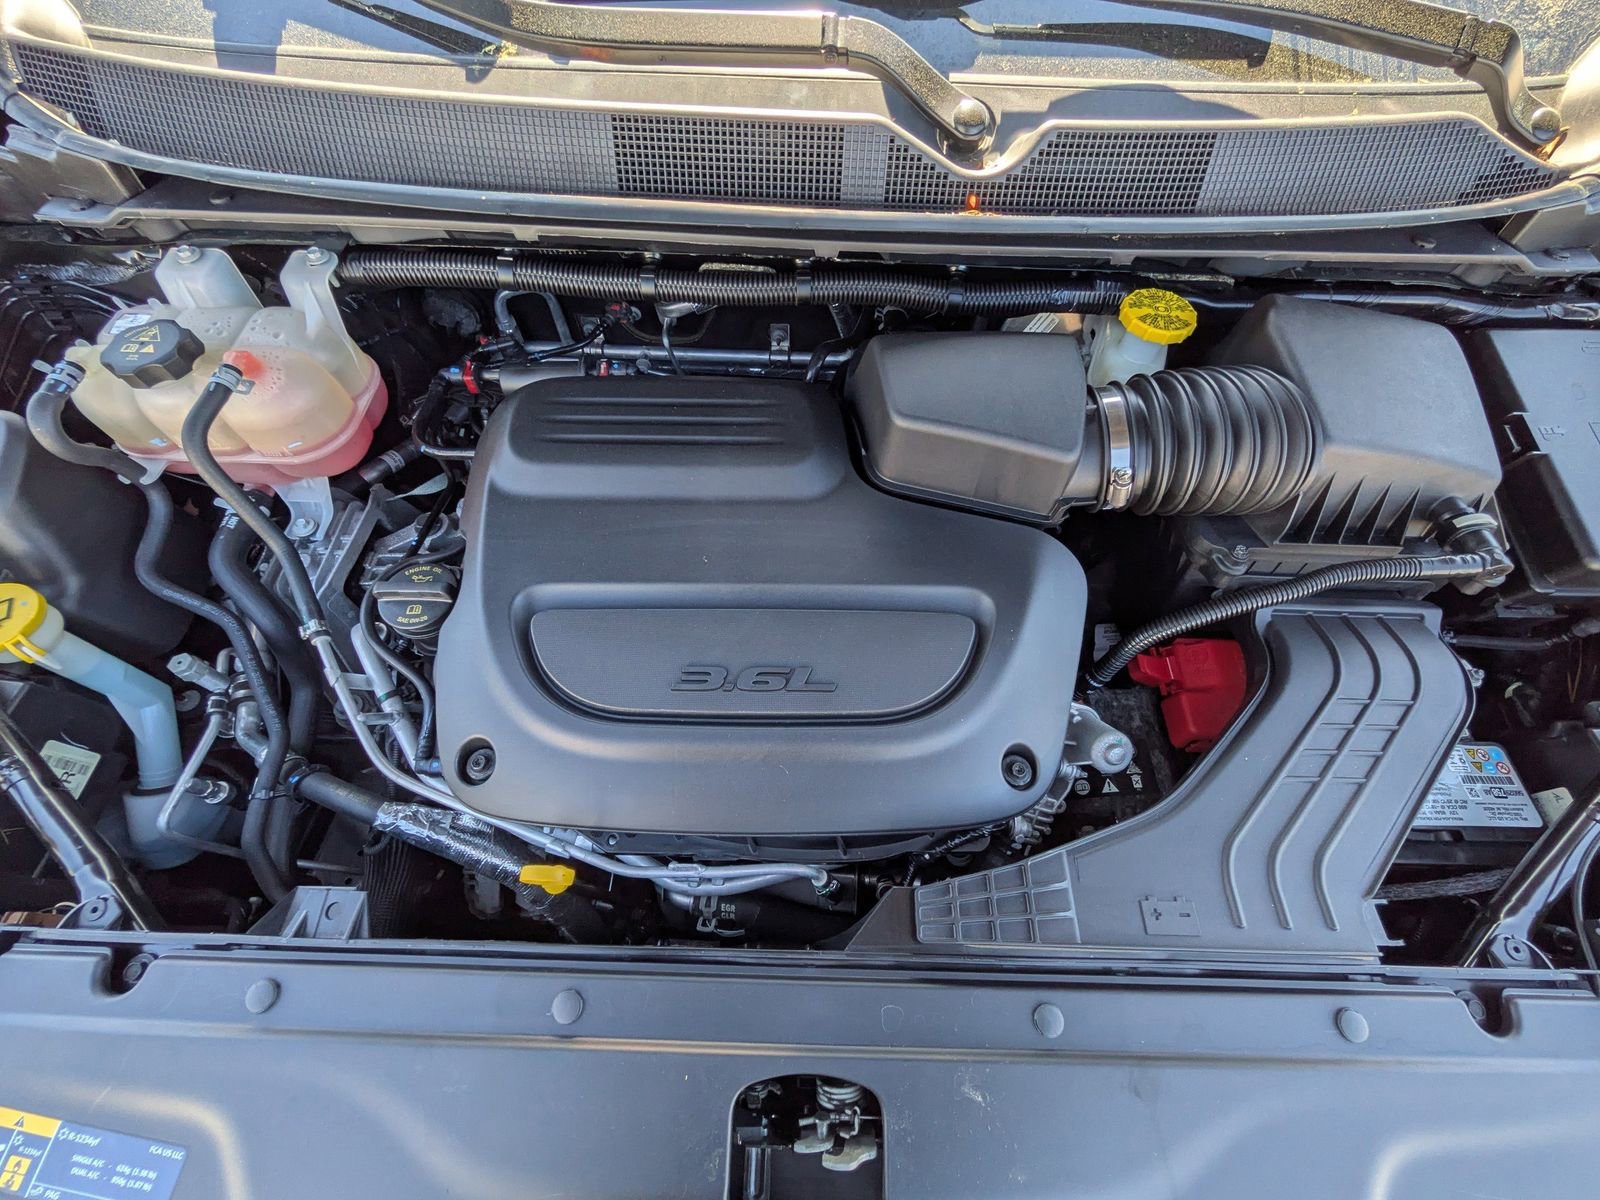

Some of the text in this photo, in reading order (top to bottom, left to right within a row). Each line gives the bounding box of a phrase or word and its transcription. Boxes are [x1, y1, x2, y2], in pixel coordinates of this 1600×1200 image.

[404, 565, 431, 576] ENGINE
[396, 615, 428, 624] SAE 0W-20
[670, 664, 838, 693] 3.6L
[721, 903, 736, 912] EGR
[148, 1144, 185, 1160] FCA US LLC
